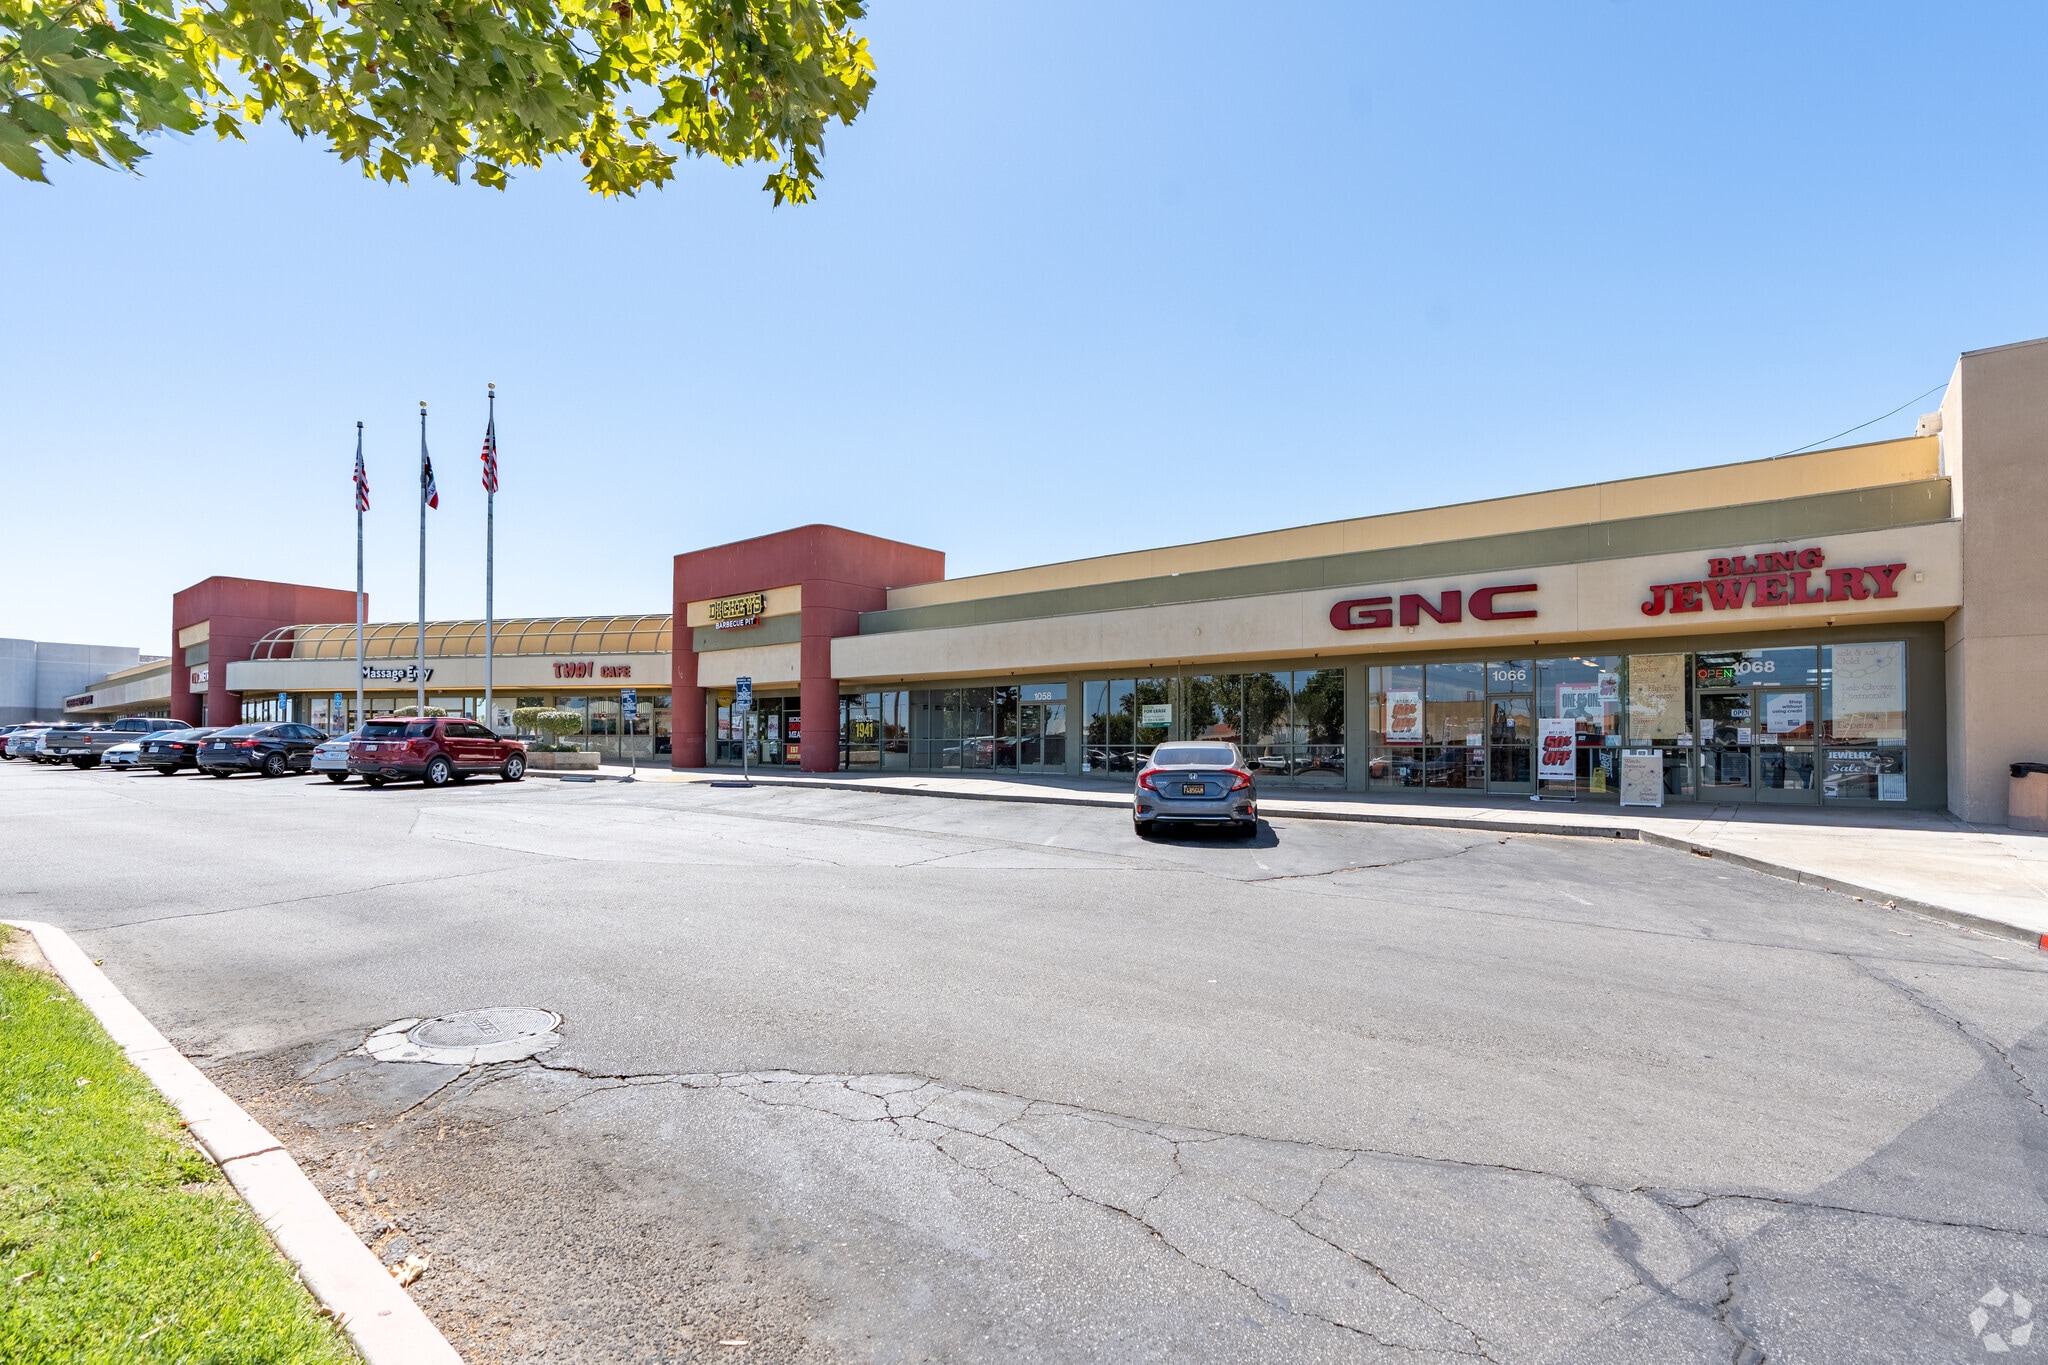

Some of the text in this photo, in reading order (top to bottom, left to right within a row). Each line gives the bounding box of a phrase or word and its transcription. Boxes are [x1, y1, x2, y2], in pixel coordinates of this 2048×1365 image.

[1707, 548, 1825, 577] BLING
[1641, 563, 1907, 616] JEWELRY
[708, 594, 762, 620] DICKEY'S
[1329, 584, 1538, 631] GNC
[715, 617, 755, 630] BARBECUE PIT
[1836, 657, 1860, 665] Gold
[362, 665, 431, 682] Massage Eny
[552, 661, 631, 679] THAI CAFE
[1697, 669, 1733, 679] OPEN
[1734, 661, 1776, 675] 1068
[1492, 670, 1526, 681] 1066
[1663, 684, 1680, 692] Hop
[1841, 683, 1860, 691] Lab
[1034, 691, 1052, 701] 1058
[1562, 693, 1577, 708] ONE
[1842, 691, 1891, 700] Diamonds
[855, 714, 873, 722] SINCE
[855, 722, 874, 738] 1941
[1542, 735, 1572, 752] 50%
[1542, 750, 1572, 766] OFF
[1828, 751, 1872, 760] JEWELRY
[1831, 763, 1862, 773] Sale
